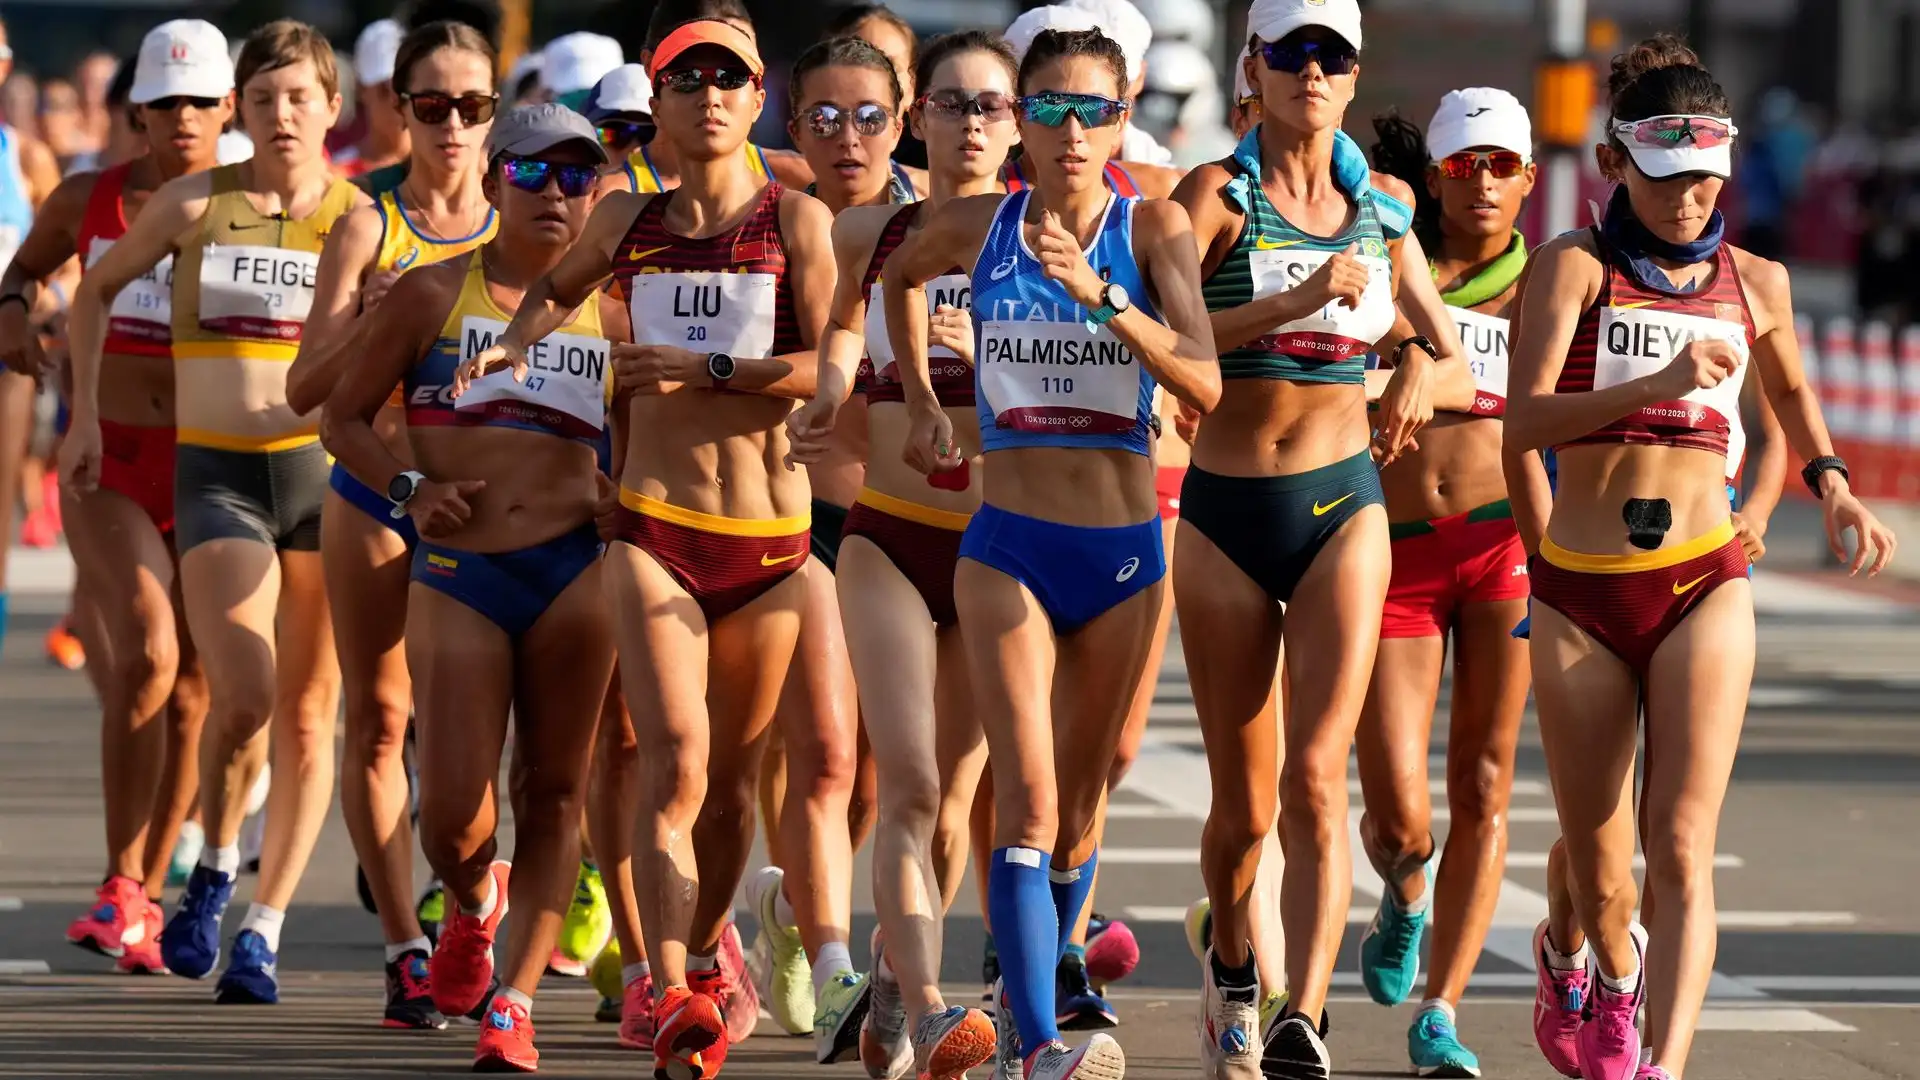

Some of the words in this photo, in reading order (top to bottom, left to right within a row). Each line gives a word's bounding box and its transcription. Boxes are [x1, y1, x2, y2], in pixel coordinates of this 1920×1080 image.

[233, 257, 315, 288] FEIGE
[264, 292, 283, 308] 73
[673, 285, 721, 317] LIU
[934, 287, 971, 313] NG
[687, 326, 706, 341] 20
[985, 338, 1133, 366] PALMISANO
[1292, 339, 1316, 348] TOKYO
[1316, 343, 1335, 352] 2020
[466, 329, 605, 381] MEJON
[929, 367, 942, 375] 020
[525, 376, 545, 392] 47
[1041, 377, 1074, 393] 110
[1024, 414, 1047, 424] TOKYO
[1047, 416, 1066, 425] 2020
[1642, 407, 1667, 416] TOKYO
[1667, 409, 1686, 418] 2020
